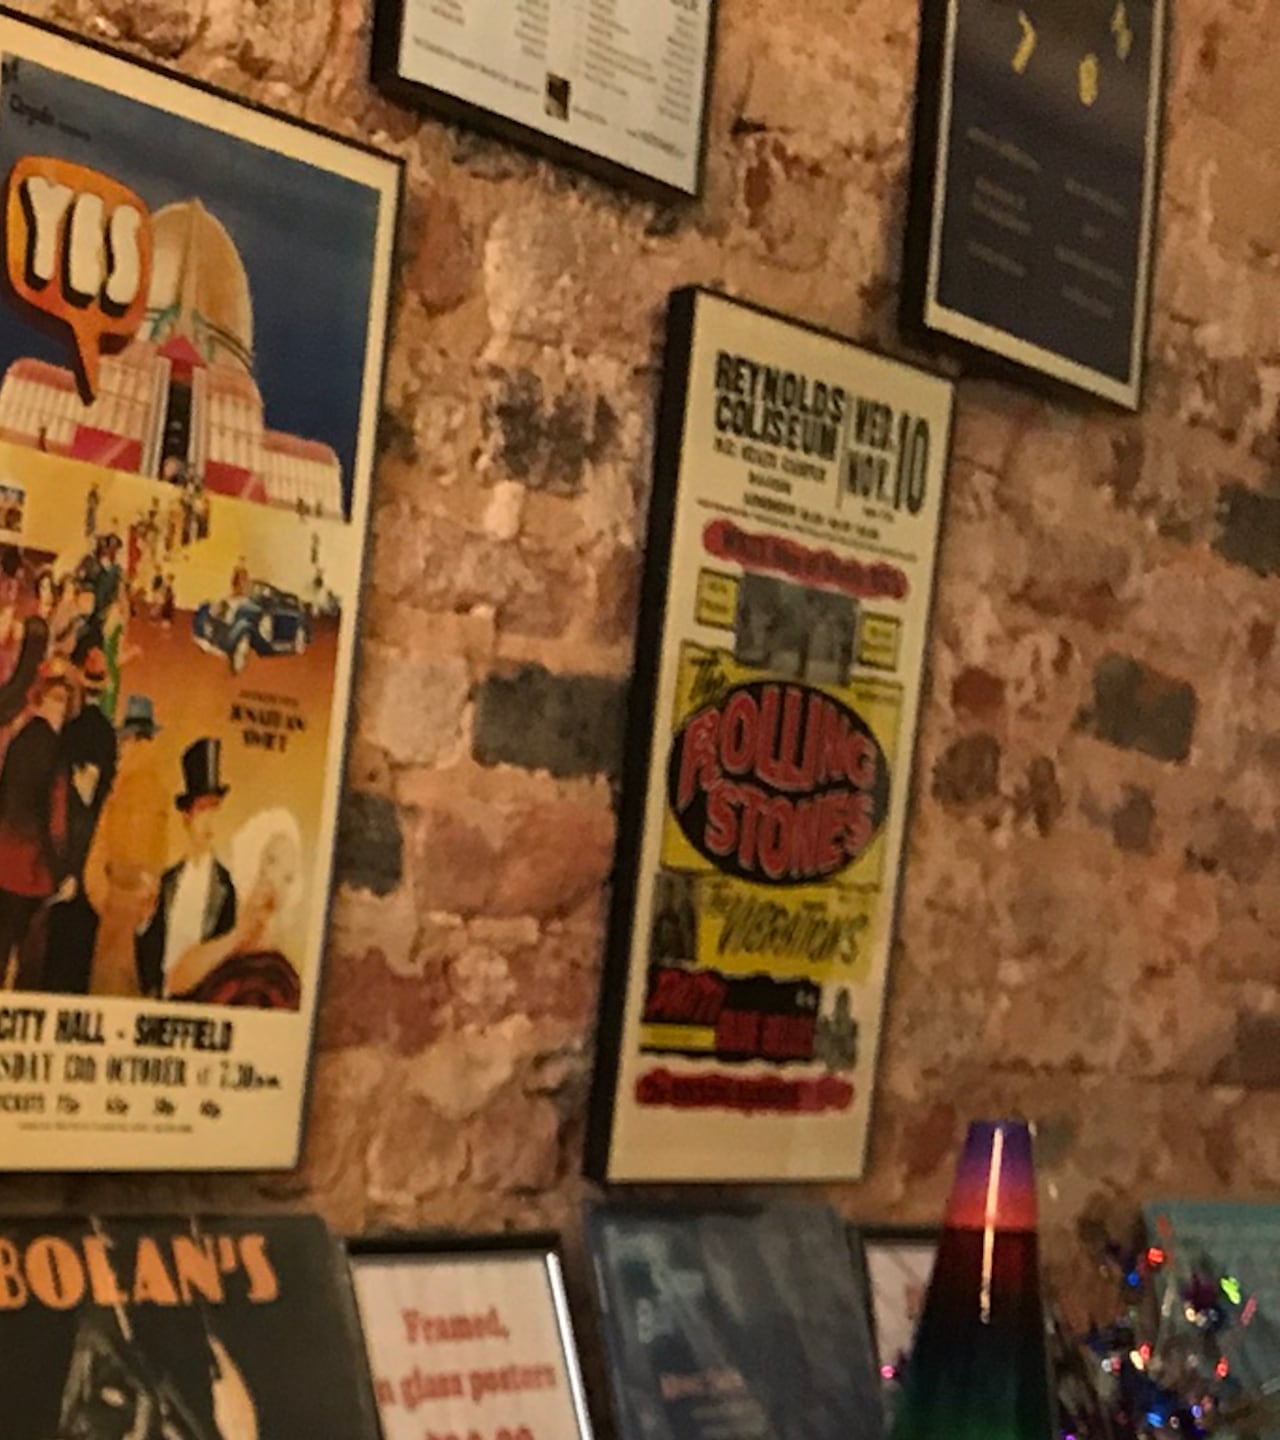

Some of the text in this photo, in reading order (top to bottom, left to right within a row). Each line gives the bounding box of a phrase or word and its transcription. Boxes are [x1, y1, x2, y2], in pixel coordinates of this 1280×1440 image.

[715, 350, 845, 424] REYNOLDS
[714, 396, 837, 461] COLISEUM
[676, 683, 876, 808] ROLLING
[704, 779, 874, 880] STONES
[54, 1008, 106, 1045] HALL
[134, 1014, 233, 1052] SHEFFIELD
[106, 1055, 186, 1086] OCTOBER
